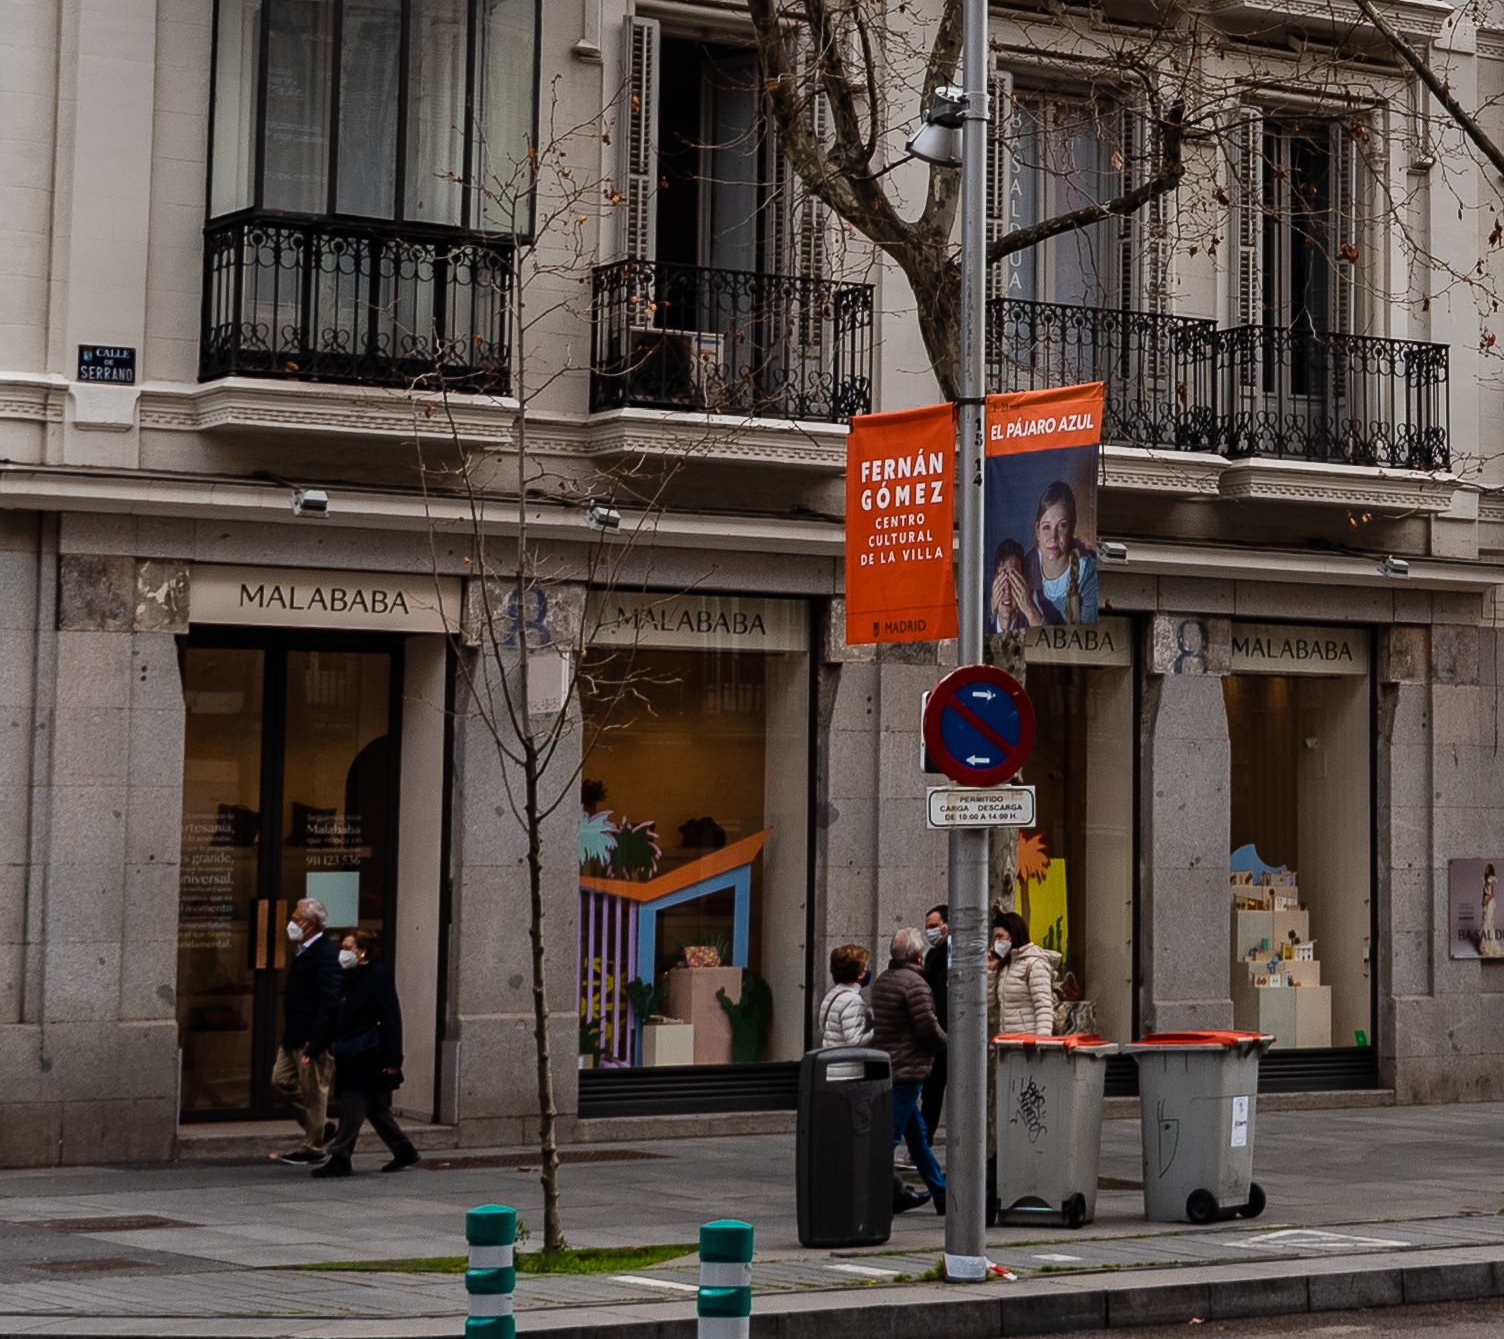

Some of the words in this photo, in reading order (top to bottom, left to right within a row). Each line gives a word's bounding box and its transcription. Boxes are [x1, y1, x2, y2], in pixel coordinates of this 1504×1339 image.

[96, 348, 130, 359] CALLE
[80, 365, 133, 382] SERRANO
[991, 424, 1004, 441] EL
[1006, 417, 1056, 438] PÁJARO
[1058, 413, 1094, 432] AZUL
[860, 449, 943, 483] FERNÁN
[861, 481, 943, 511] GÓMEZ
[875, 513, 925, 530] CENTRO
[868, 529, 933, 548] CULTURAL
[860, 553, 874, 566] DE
[880, 551, 895, 564] LA
[903, 546, 943, 561] VILLA
[239, 583, 409, 615] MALABABA
[617, 606, 766, 636] MALABABA
[885, 620, 926, 634] MADRID
[1232, 636, 1353, 662] MALABABA
[978, 804, 1022, 812] DESCARGA
[307, 823, 361, 835] Malababa
